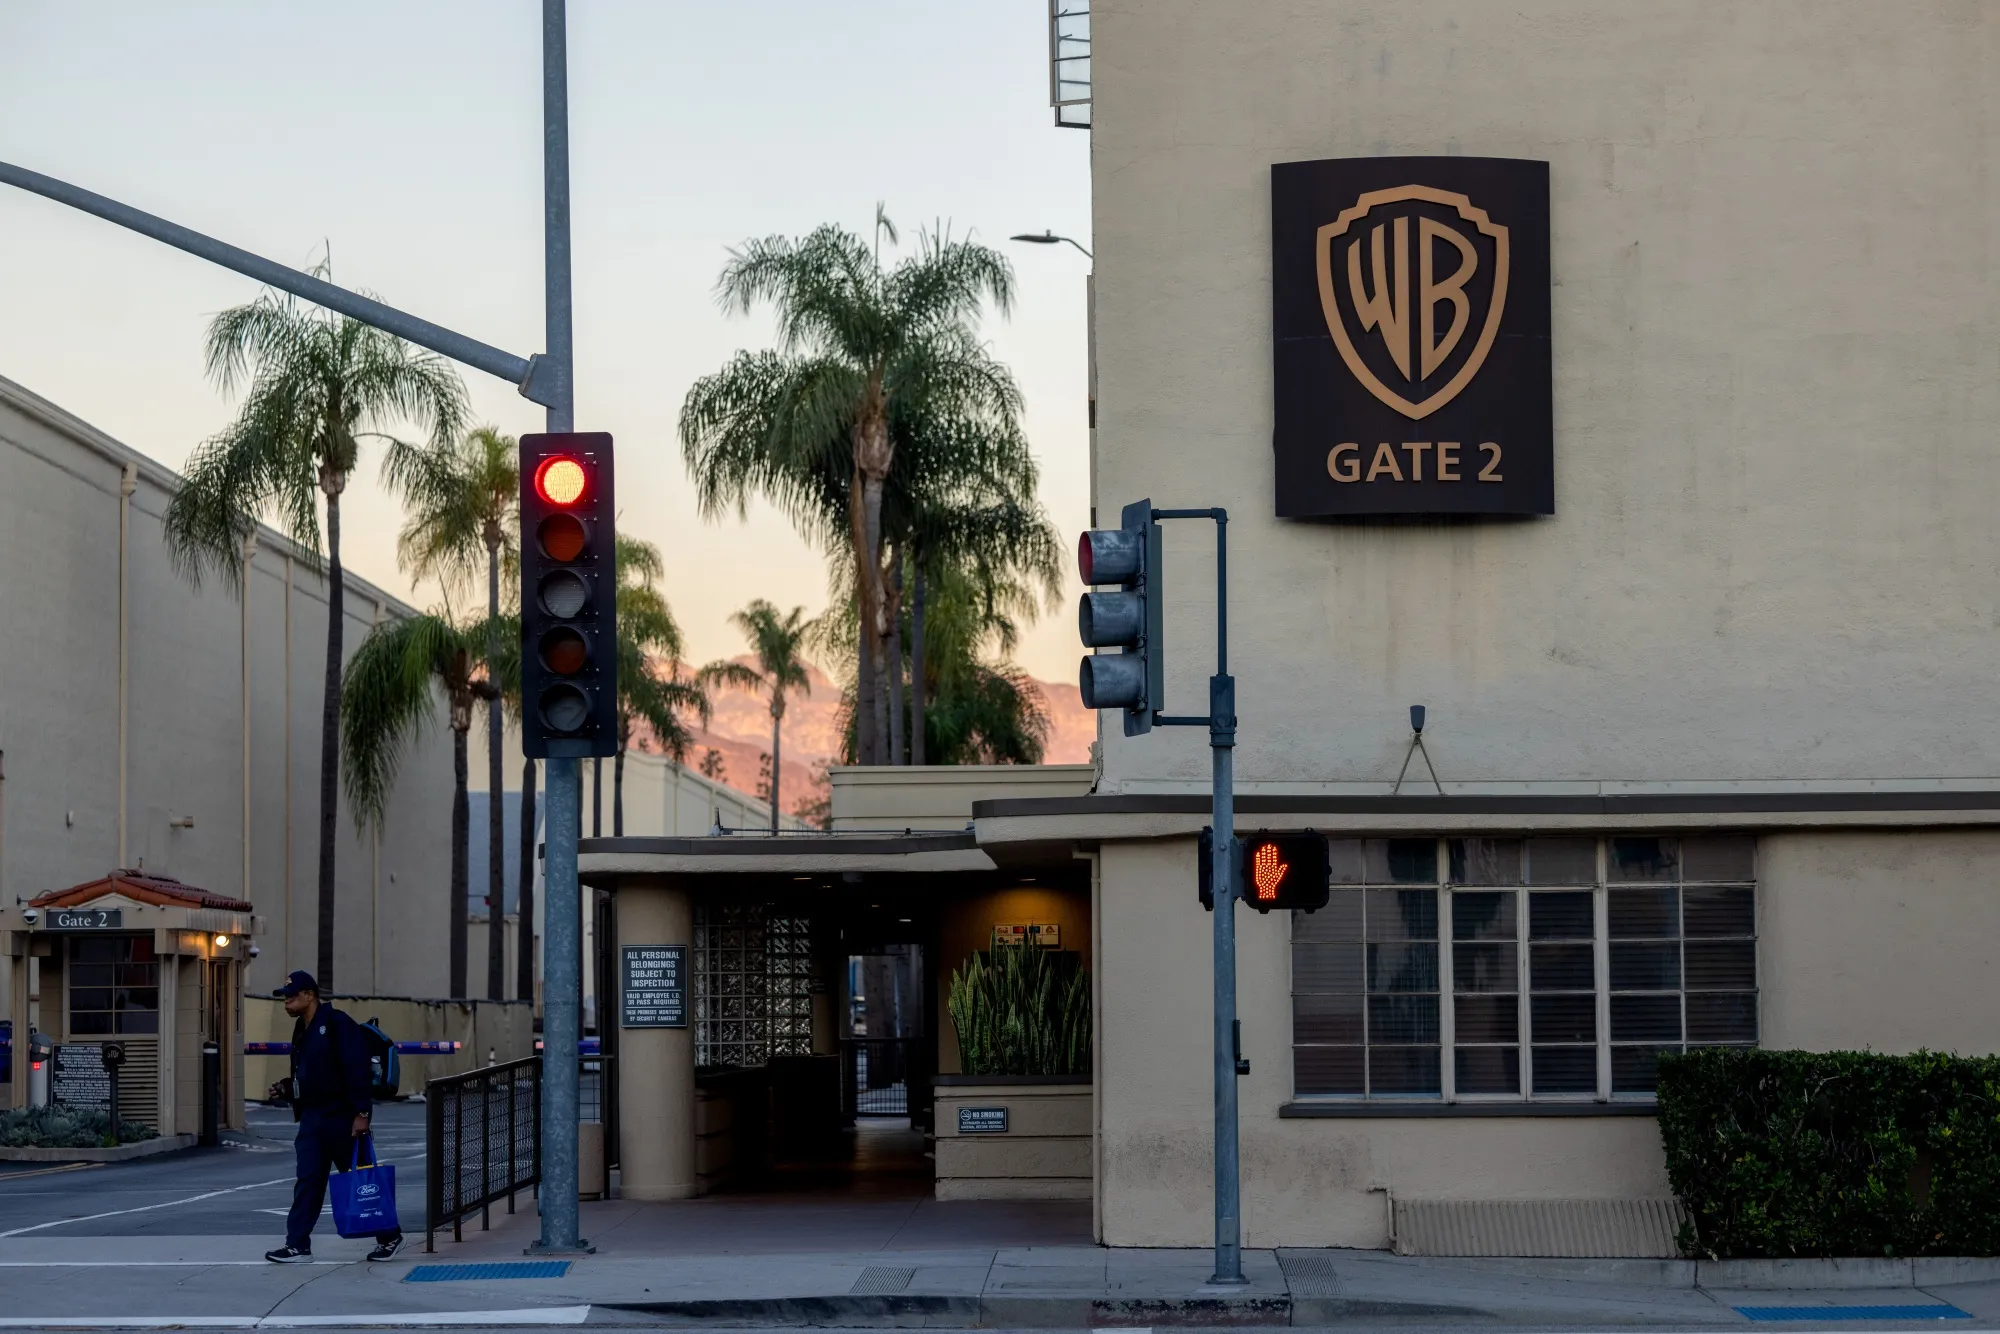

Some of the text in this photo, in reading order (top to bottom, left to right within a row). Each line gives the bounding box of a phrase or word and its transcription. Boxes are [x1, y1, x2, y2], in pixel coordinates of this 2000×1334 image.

[1347, 216, 1478, 383] WB
[1326, 441, 1503, 483] GATE 2
[58, 912, 108, 927] Gate 2
[627, 951, 680, 959] ALL PERSONAL
[631, 960, 675, 968] BELONGINGS
[631, 979, 675, 987] INSPECTION
[360, 1185, 376, 1194] Ford
